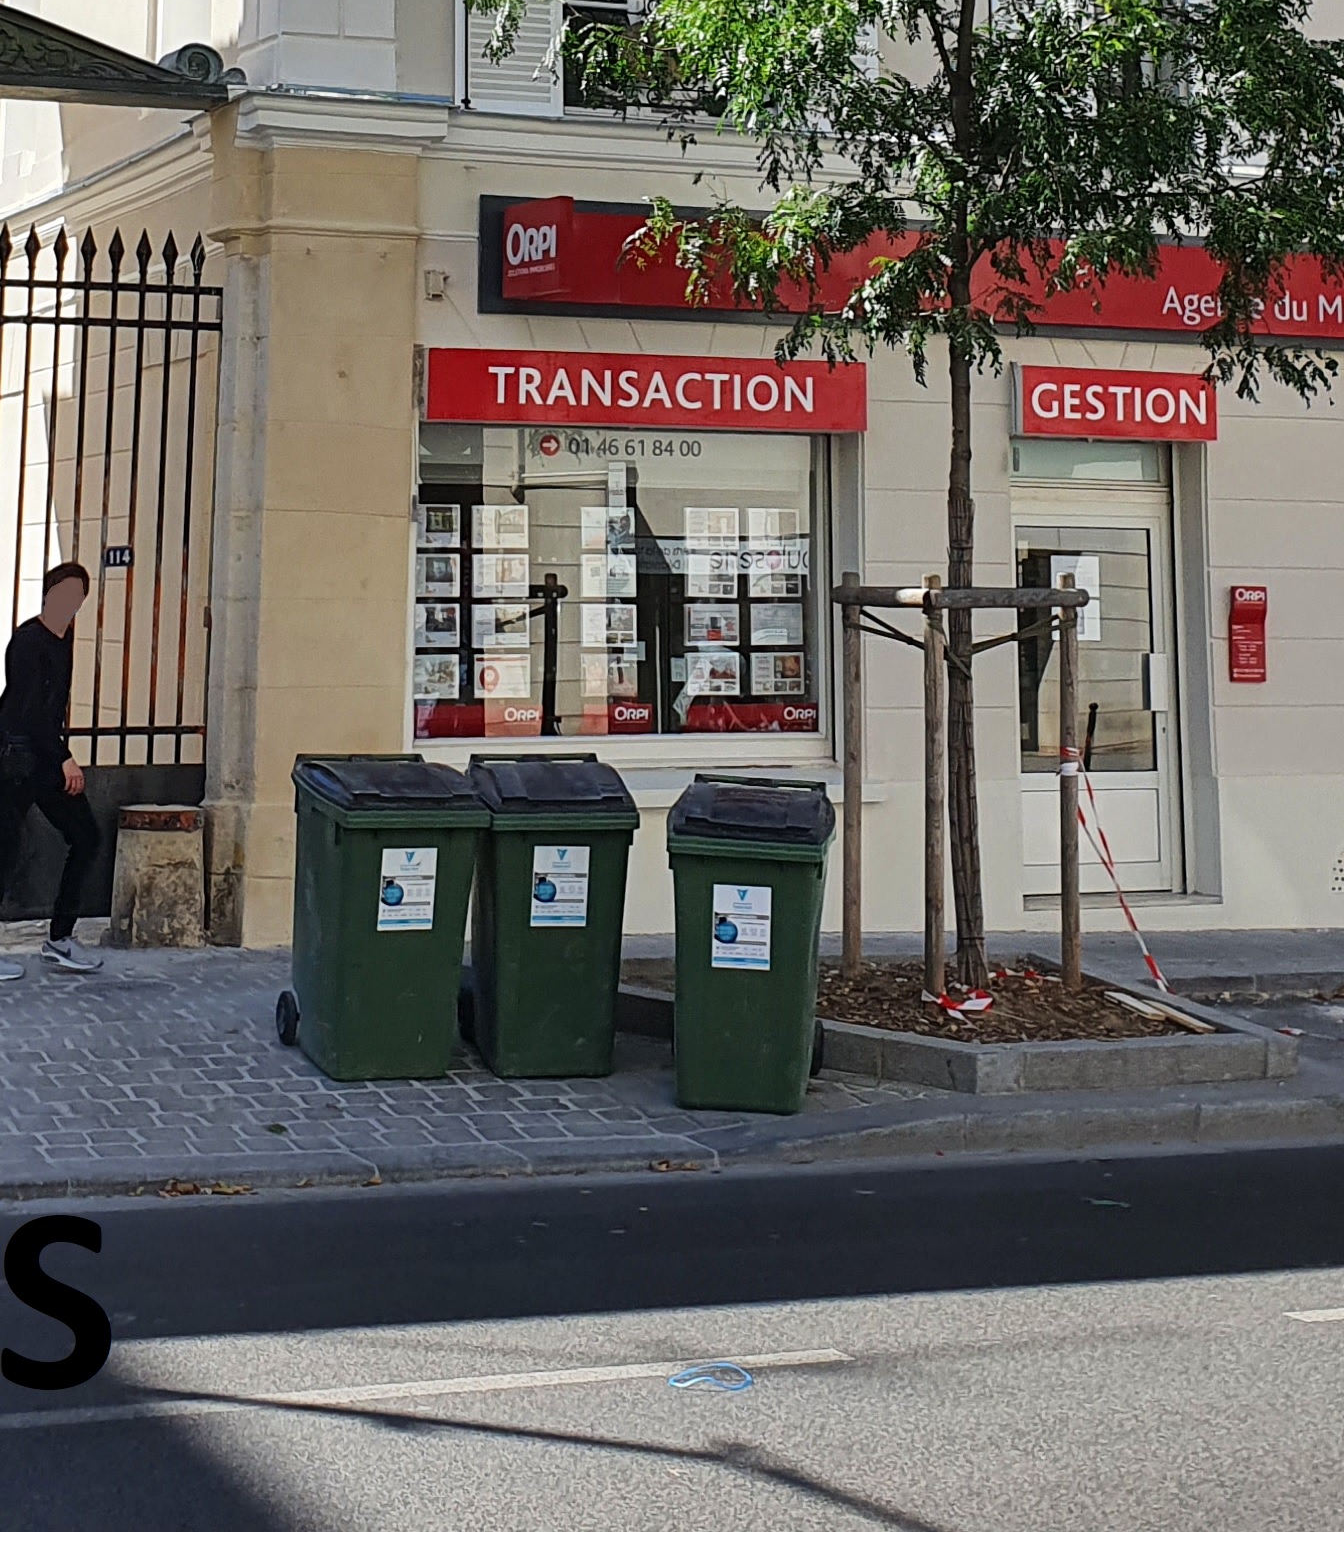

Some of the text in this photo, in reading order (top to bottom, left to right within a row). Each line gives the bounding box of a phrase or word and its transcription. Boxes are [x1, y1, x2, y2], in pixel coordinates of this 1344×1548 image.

[506, 223, 557, 266] ORPI
[1274, 290, 1307, 321] du
[489, 367, 812, 411] TRANSACTION
[1032, 384, 1206, 424] GESTION
[598, 438, 620, 456] 46
[624, 439, 645, 456] 61
[652, 439, 674, 456] 84
[678, 440, 703, 457] 00
[109, 549, 131, 564] 114
[1235, 588, 1265, 601] ORPI
[504, 708, 539, 723] ORPI
[614, 706, 649, 722] ORPI
[783, 706, 816, 722] ORPI
